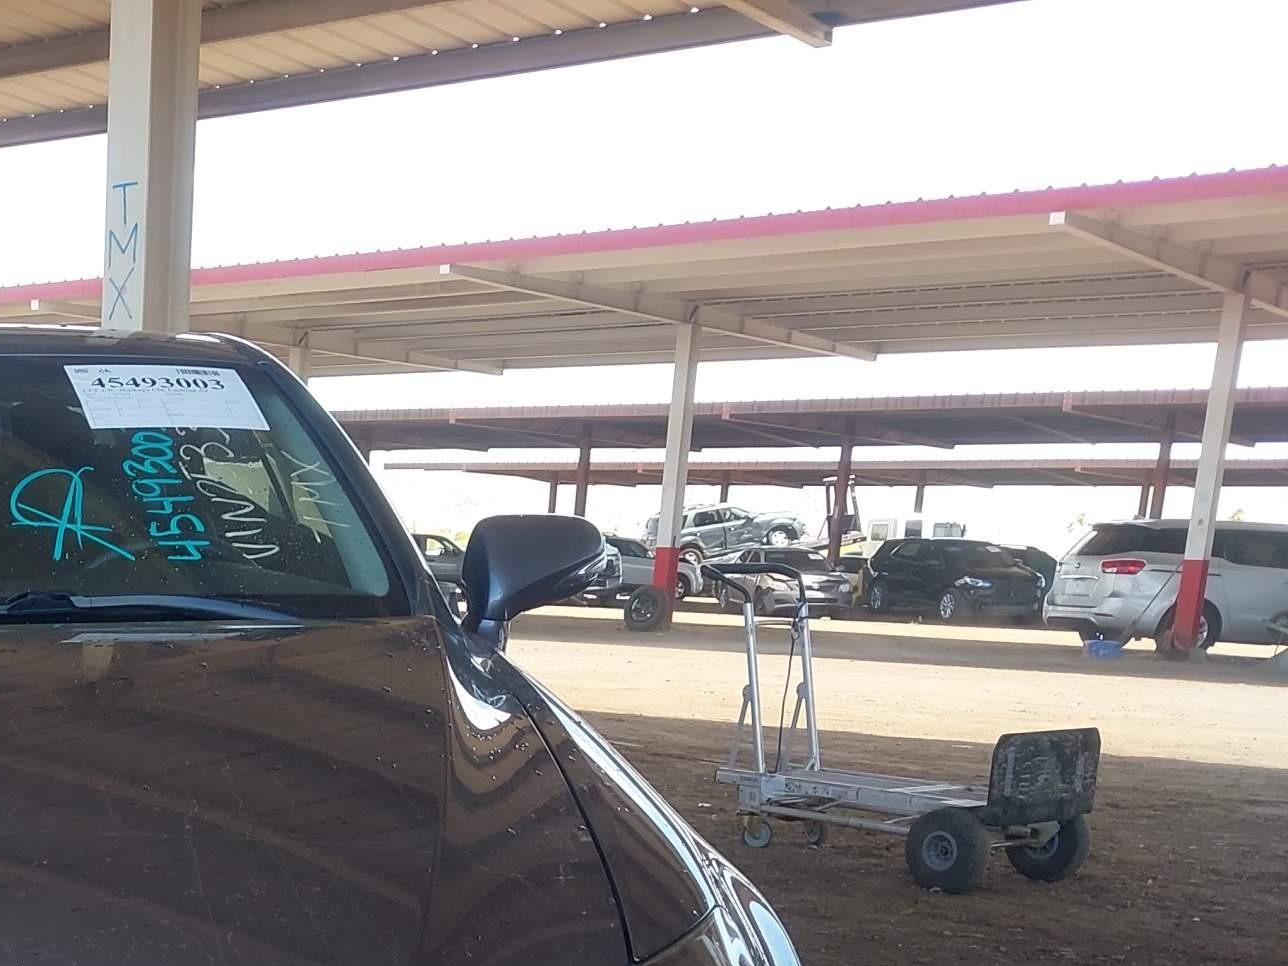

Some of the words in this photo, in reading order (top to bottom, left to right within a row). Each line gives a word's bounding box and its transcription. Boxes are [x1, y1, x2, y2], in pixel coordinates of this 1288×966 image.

[108, 181, 139, 321] TMX
[91, 376, 225, 392] 45493003
[122, 428, 211, 561] 4549300
